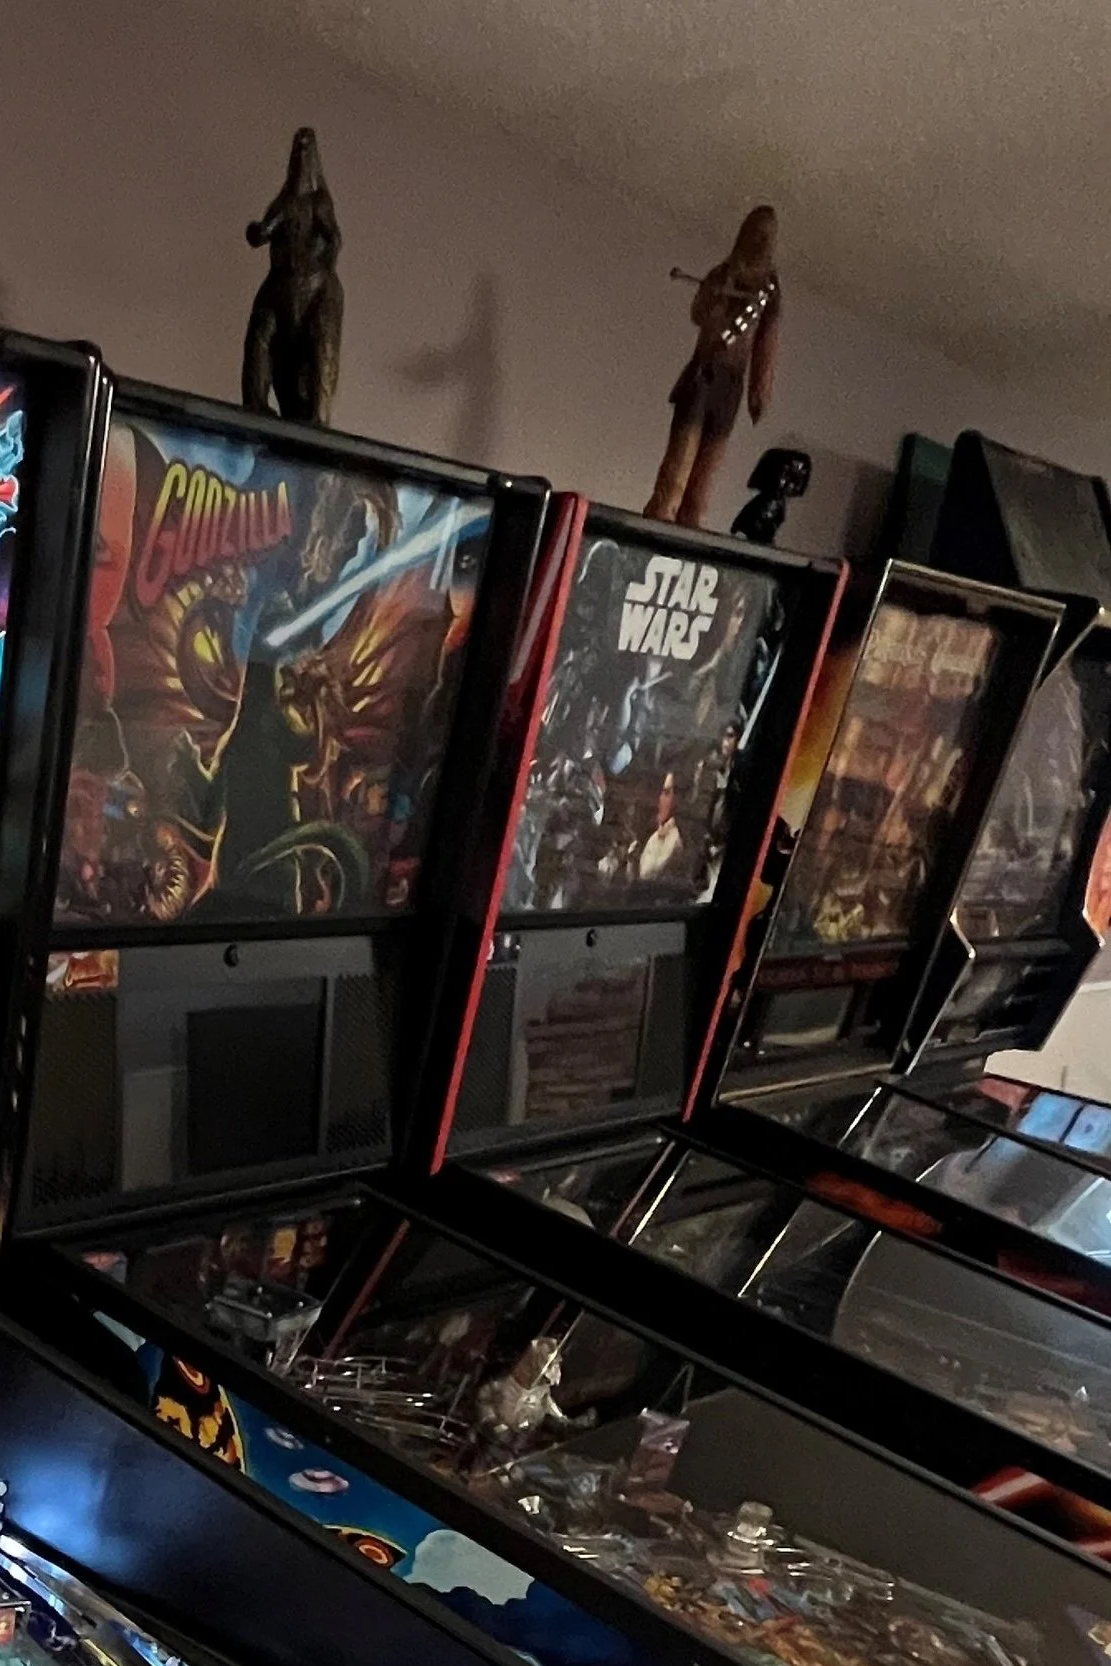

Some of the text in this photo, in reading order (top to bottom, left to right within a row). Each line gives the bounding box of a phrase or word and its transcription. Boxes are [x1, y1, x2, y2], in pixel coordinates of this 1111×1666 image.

[136, 461, 293, 607] GODZILLA
[625, 555, 719, 614] STAR
[618, 602, 714, 660] WARS
